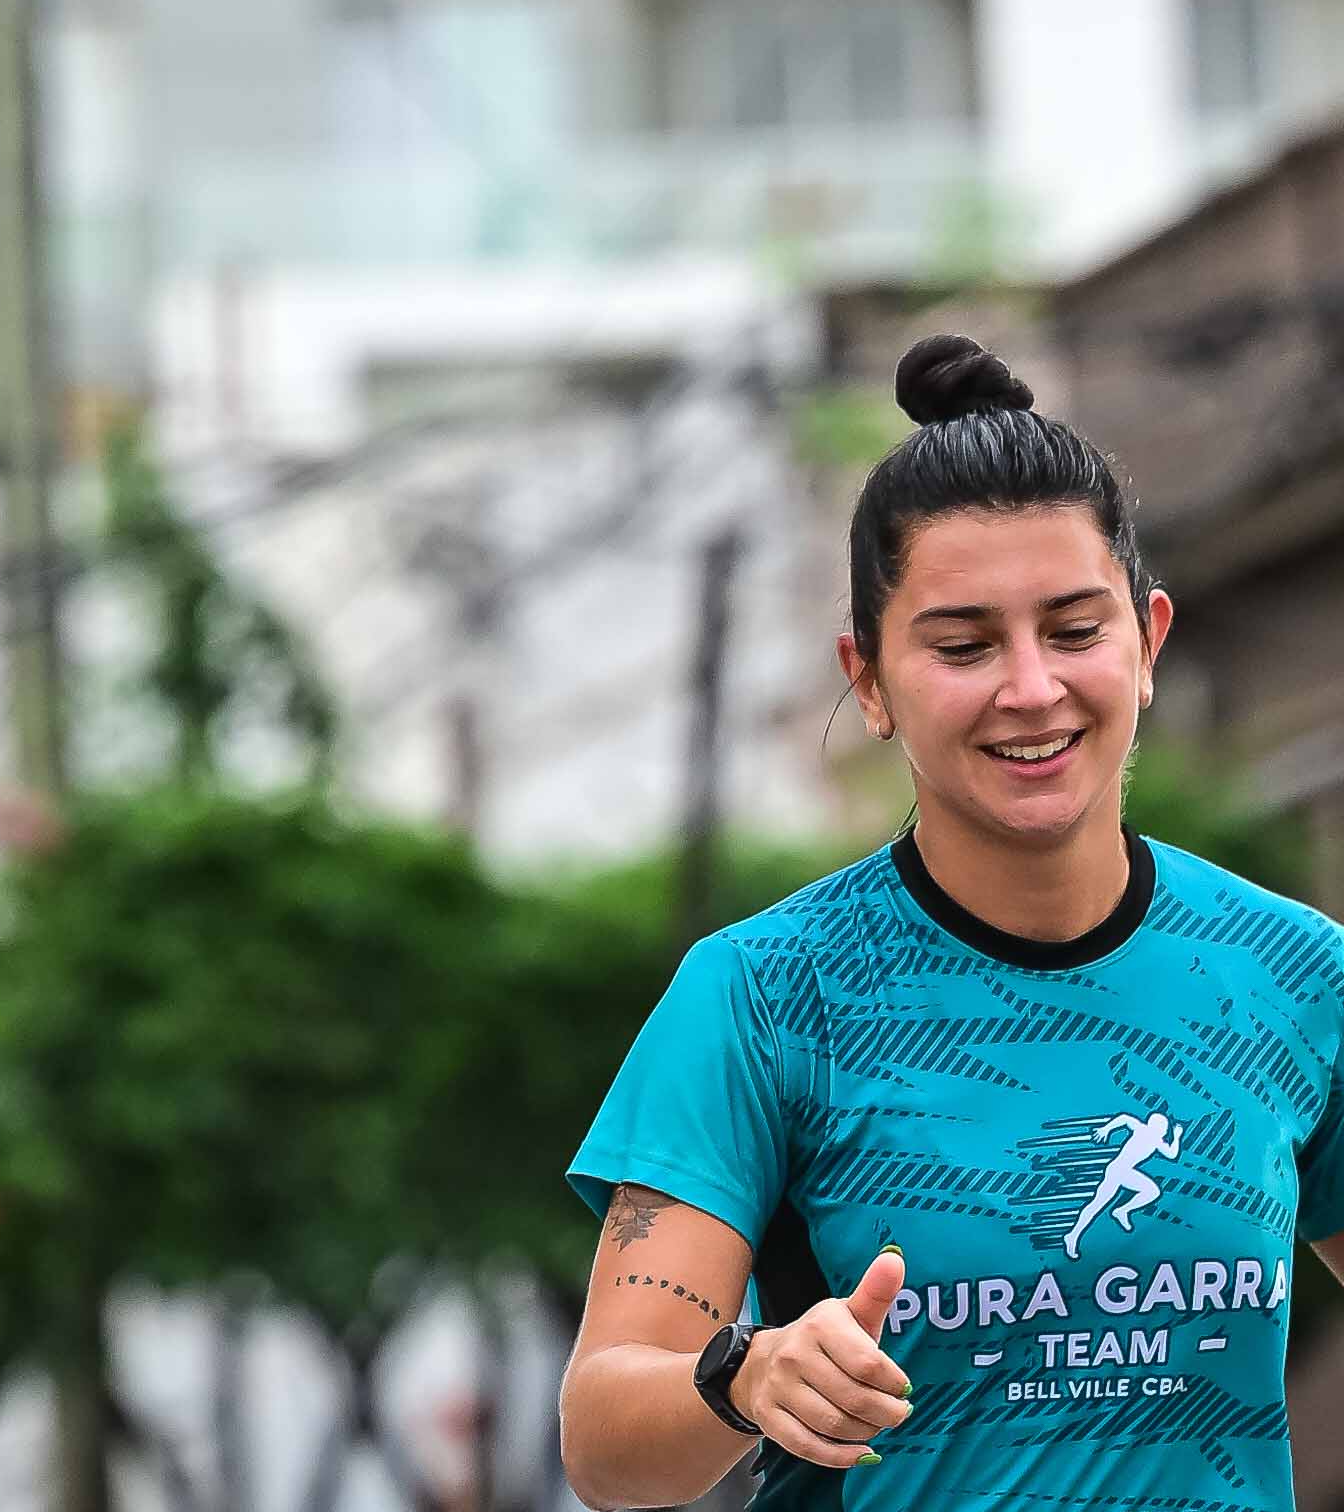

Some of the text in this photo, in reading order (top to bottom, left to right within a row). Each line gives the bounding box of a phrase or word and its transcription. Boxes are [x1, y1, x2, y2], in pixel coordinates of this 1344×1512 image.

[888, 1258, 1289, 1334] PURA GARRA
[1038, 1328, 1169, 1369] TEAM
[1007, 1379, 1062, 1402] BELL
[1068, 1377, 1130, 1400] VILLE
